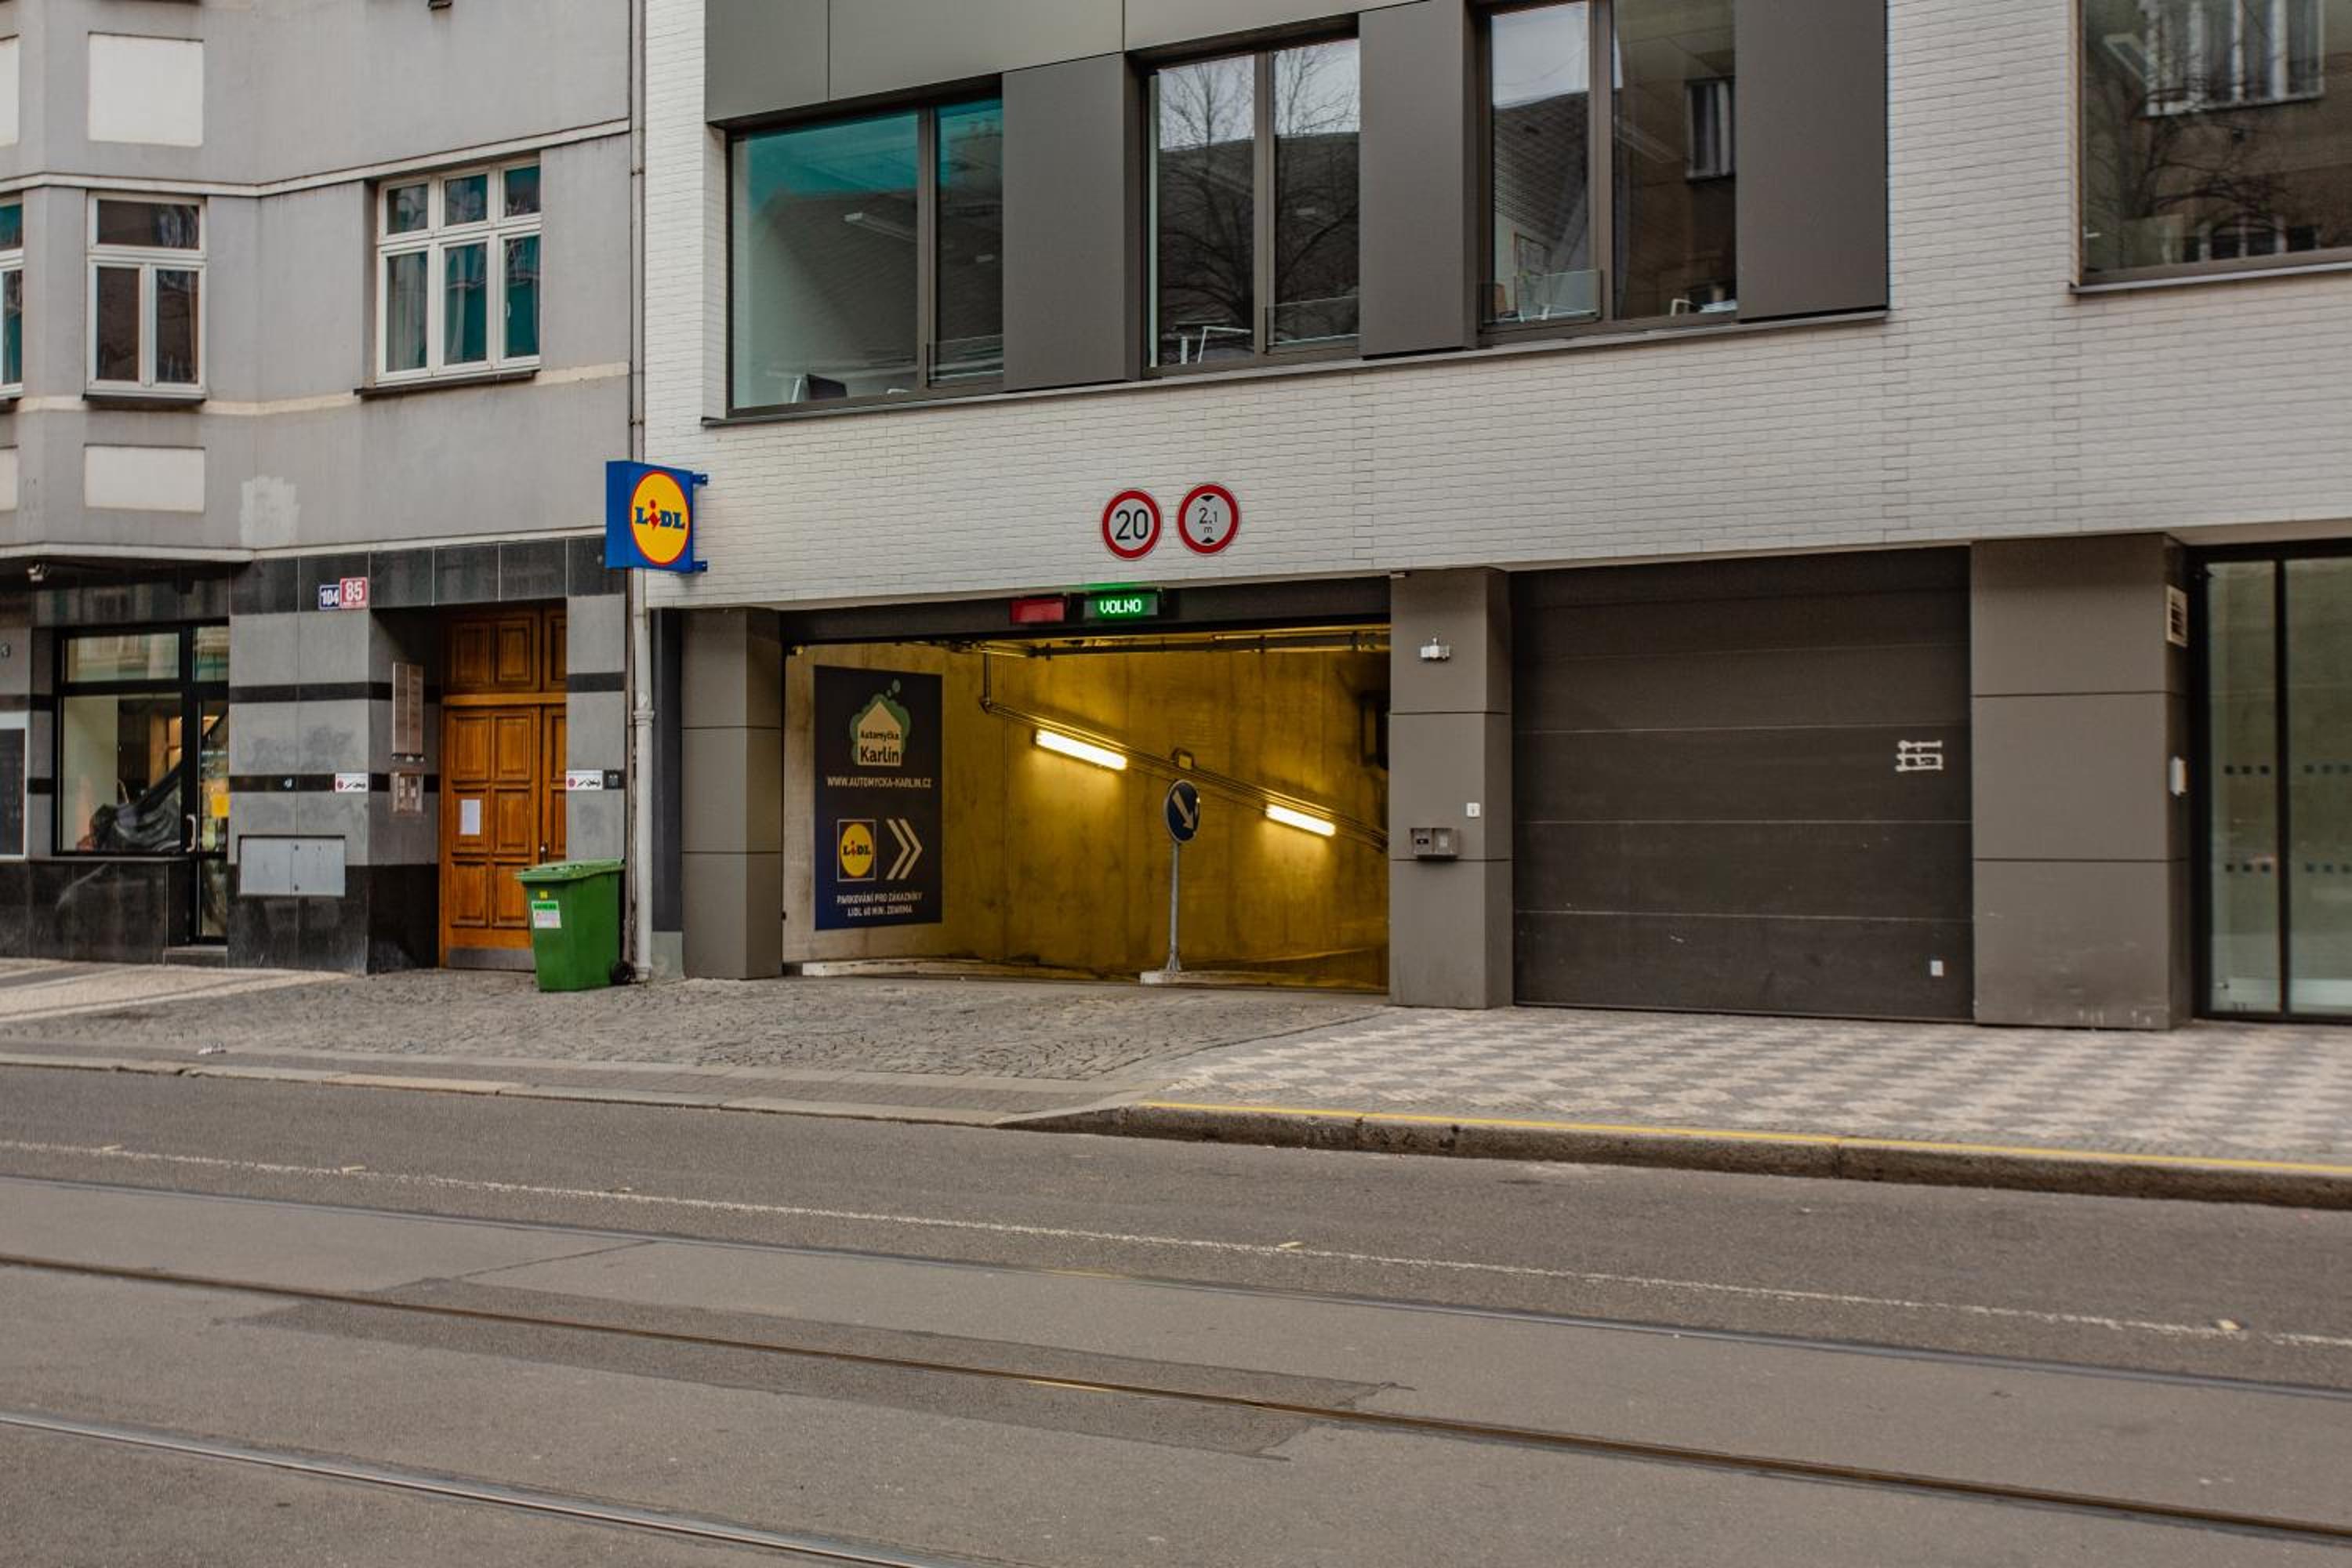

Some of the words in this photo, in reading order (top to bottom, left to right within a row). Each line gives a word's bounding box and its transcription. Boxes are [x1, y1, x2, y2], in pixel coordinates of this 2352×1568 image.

[1116, 509, 1149, 540] 20
[321, 589, 339, 605] 104
[346, 581, 363, 601] 85
[1099, 598, 1142, 614] VOLNO
